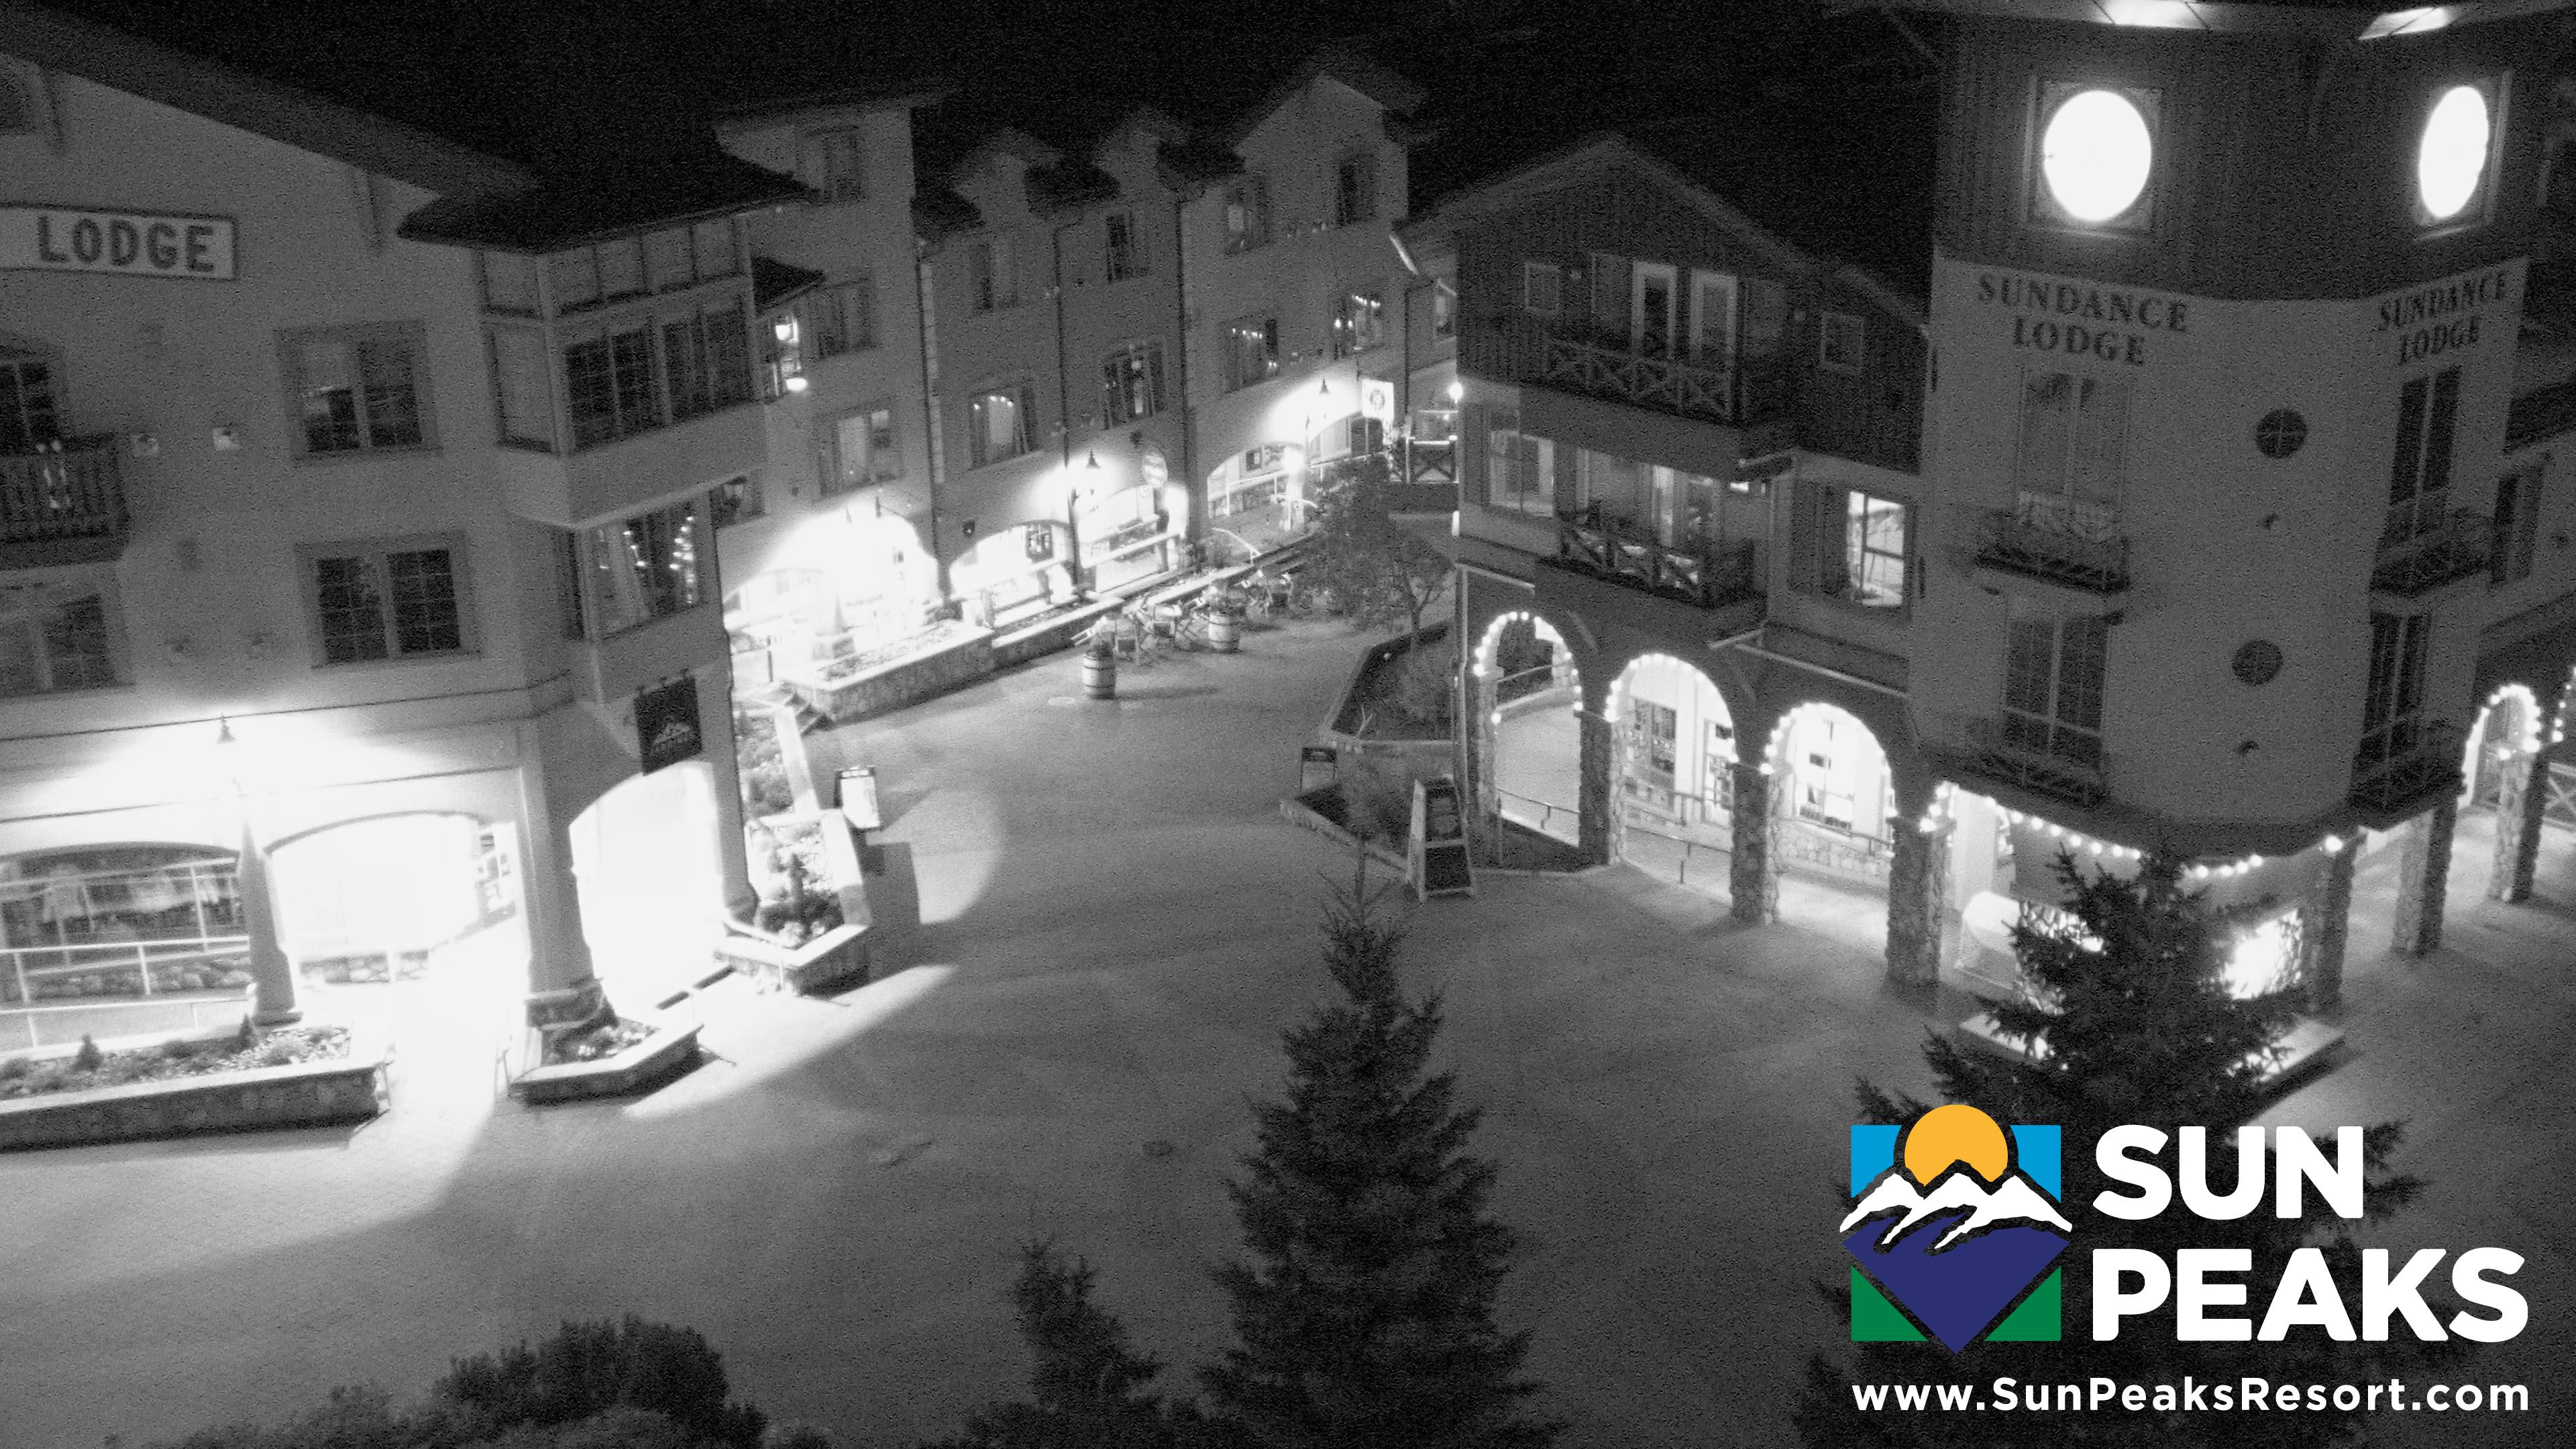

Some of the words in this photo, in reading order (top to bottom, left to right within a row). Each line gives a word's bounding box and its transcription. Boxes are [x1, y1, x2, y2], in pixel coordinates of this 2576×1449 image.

[37, 214, 215, 272] LODGE
[1978, 272, 2188, 333] SUNDANCE
[2378, 271, 2506, 331] SUNDANCE
[2012, 315, 2145, 366] LODGE
[2398, 315, 2481, 366] LODGE
